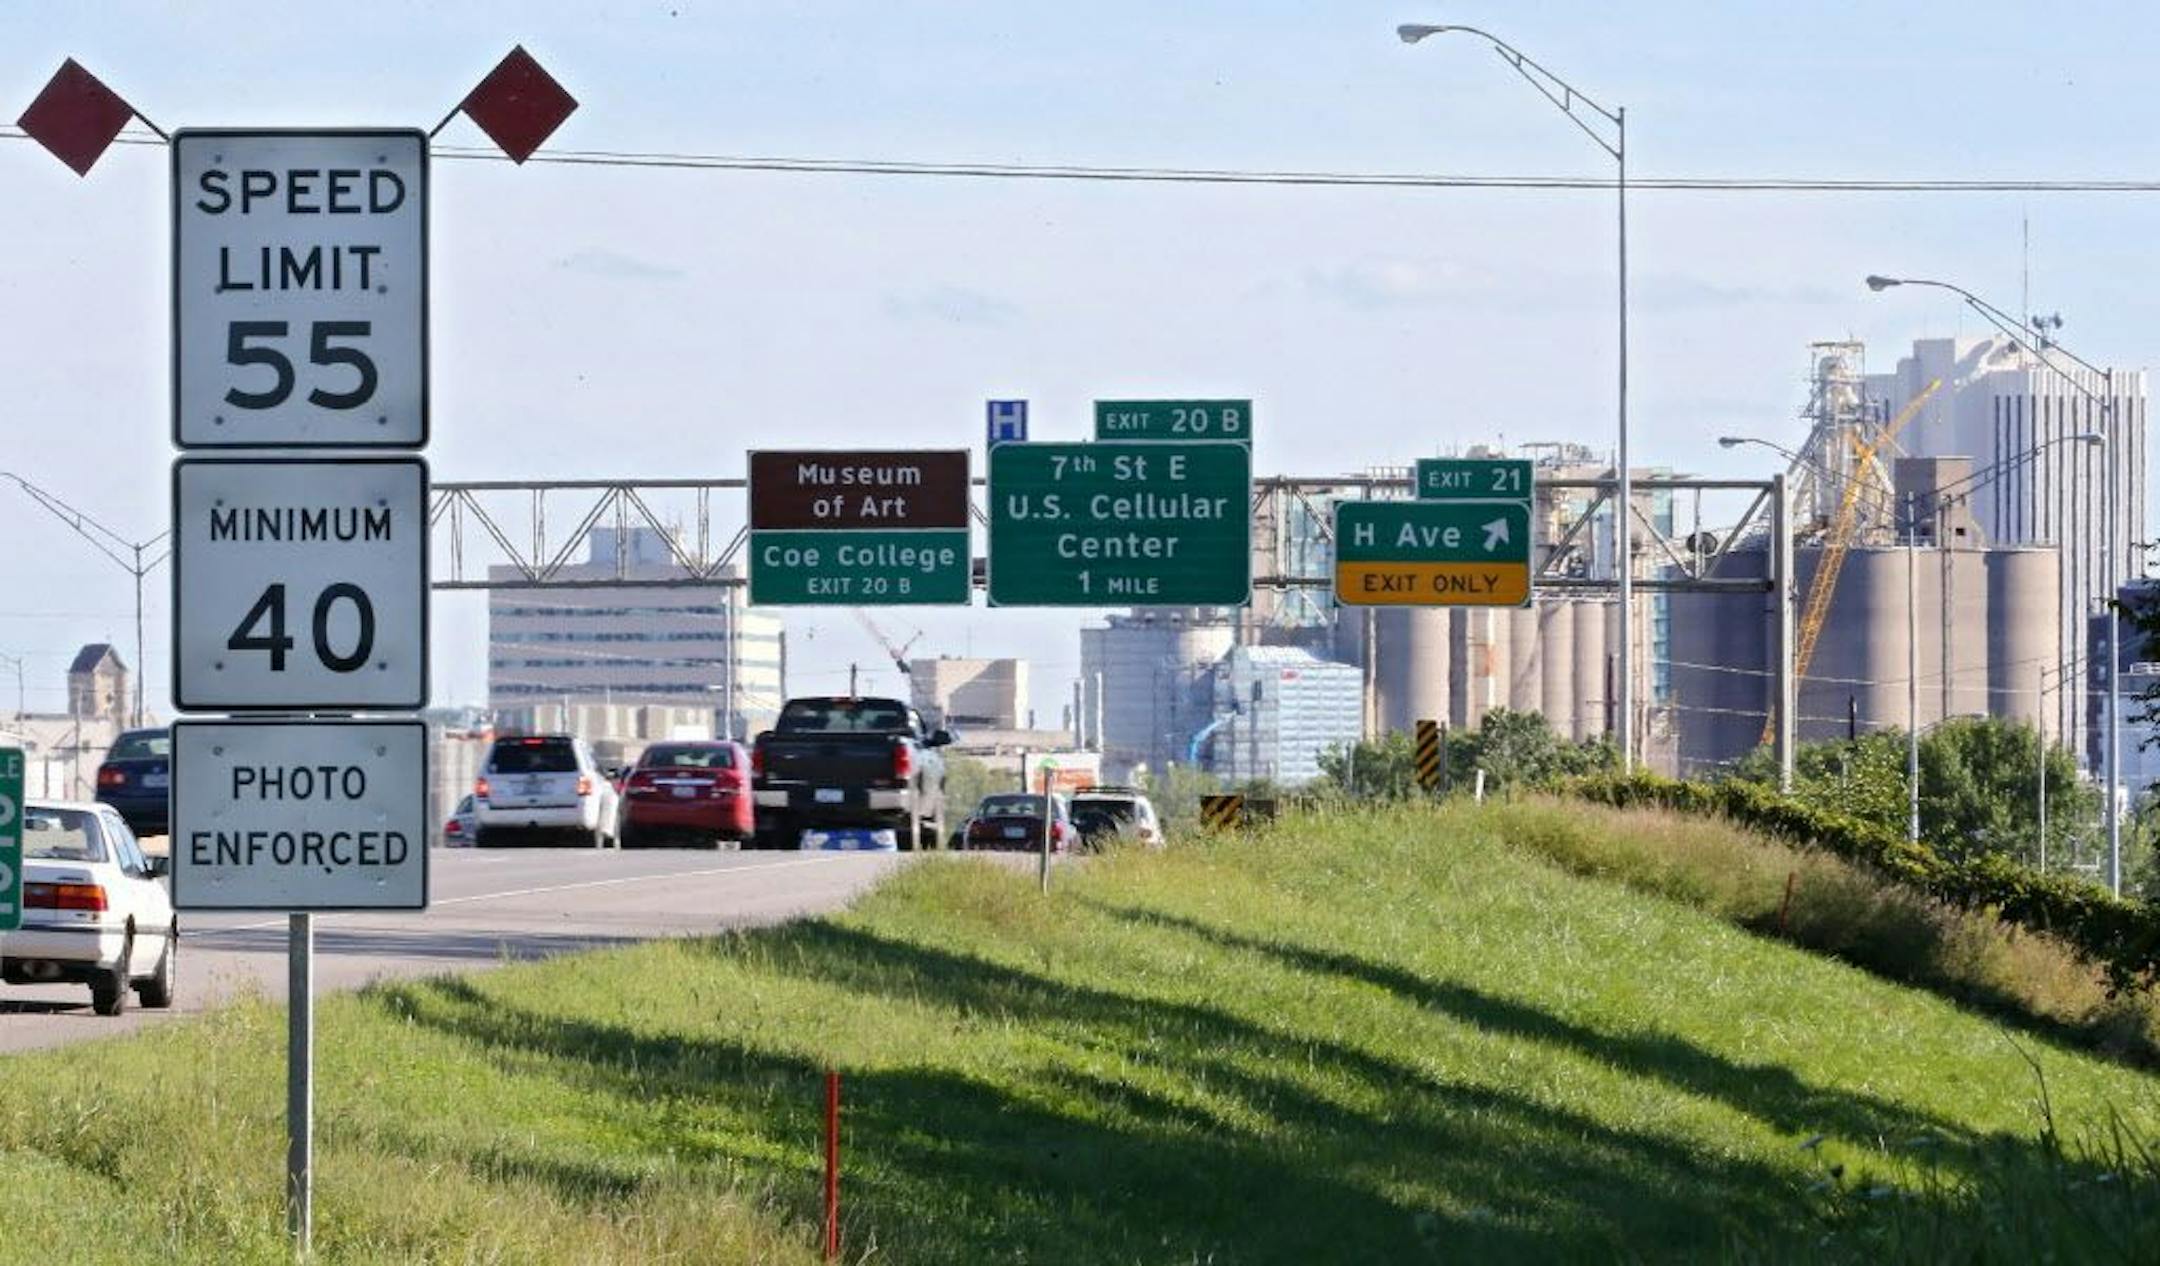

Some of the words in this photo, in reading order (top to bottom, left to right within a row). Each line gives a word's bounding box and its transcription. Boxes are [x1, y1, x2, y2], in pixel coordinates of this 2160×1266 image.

[196, 169, 406, 215] SPEED
[220, 246, 381, 290] LIMIT
[223, 320, 378, 411] 55
[992, 403, 1023, 440] H
[1106, 412, 1150, 430] EXIT
[1171, 408, 1209, 433] 20
[1222, 408, 1240, 432] B
[798, 463, 921, 486] Museum
[1050, 455, 1096, 481] 7th
[1113, 455, 1147, 481] St
[1169, 455, 1186, 480] E
[1428, 470, 1473, 488] EXIT
[1492, 467, 1521, 491] 21
[813, 494, 845, 518] of
[859, 495, 906, 518] Art
[1008, 494, 1071, 521] U.S.
[1090, 492, 1228, 521] Cellular
[210, 507, 391, 542] MINIMUM
[1354, 522, 1375, 546] H
[1396, 522, 1461, 548] Ave
[763, 545, 820, 567] Coe
[838, 543, 955, 573] College
[1057, 532, 1179, 559] Center
[807, 577, 852, 595] EXIT
[861, 576, 888, 595] 20
[898, 577, 911, 595] B
[1078, 570, 1090, 594] 1
[1108, 577, 1159, 595] MILE
[1363, 573, 1417, 593] EXIT
[1432, 573, 1499, 594] ONLY
[227, 582, 375, 674] 40
[233, 765, 366, 800] PHOTO
[191, 831, 408, 866] ENFORCED
